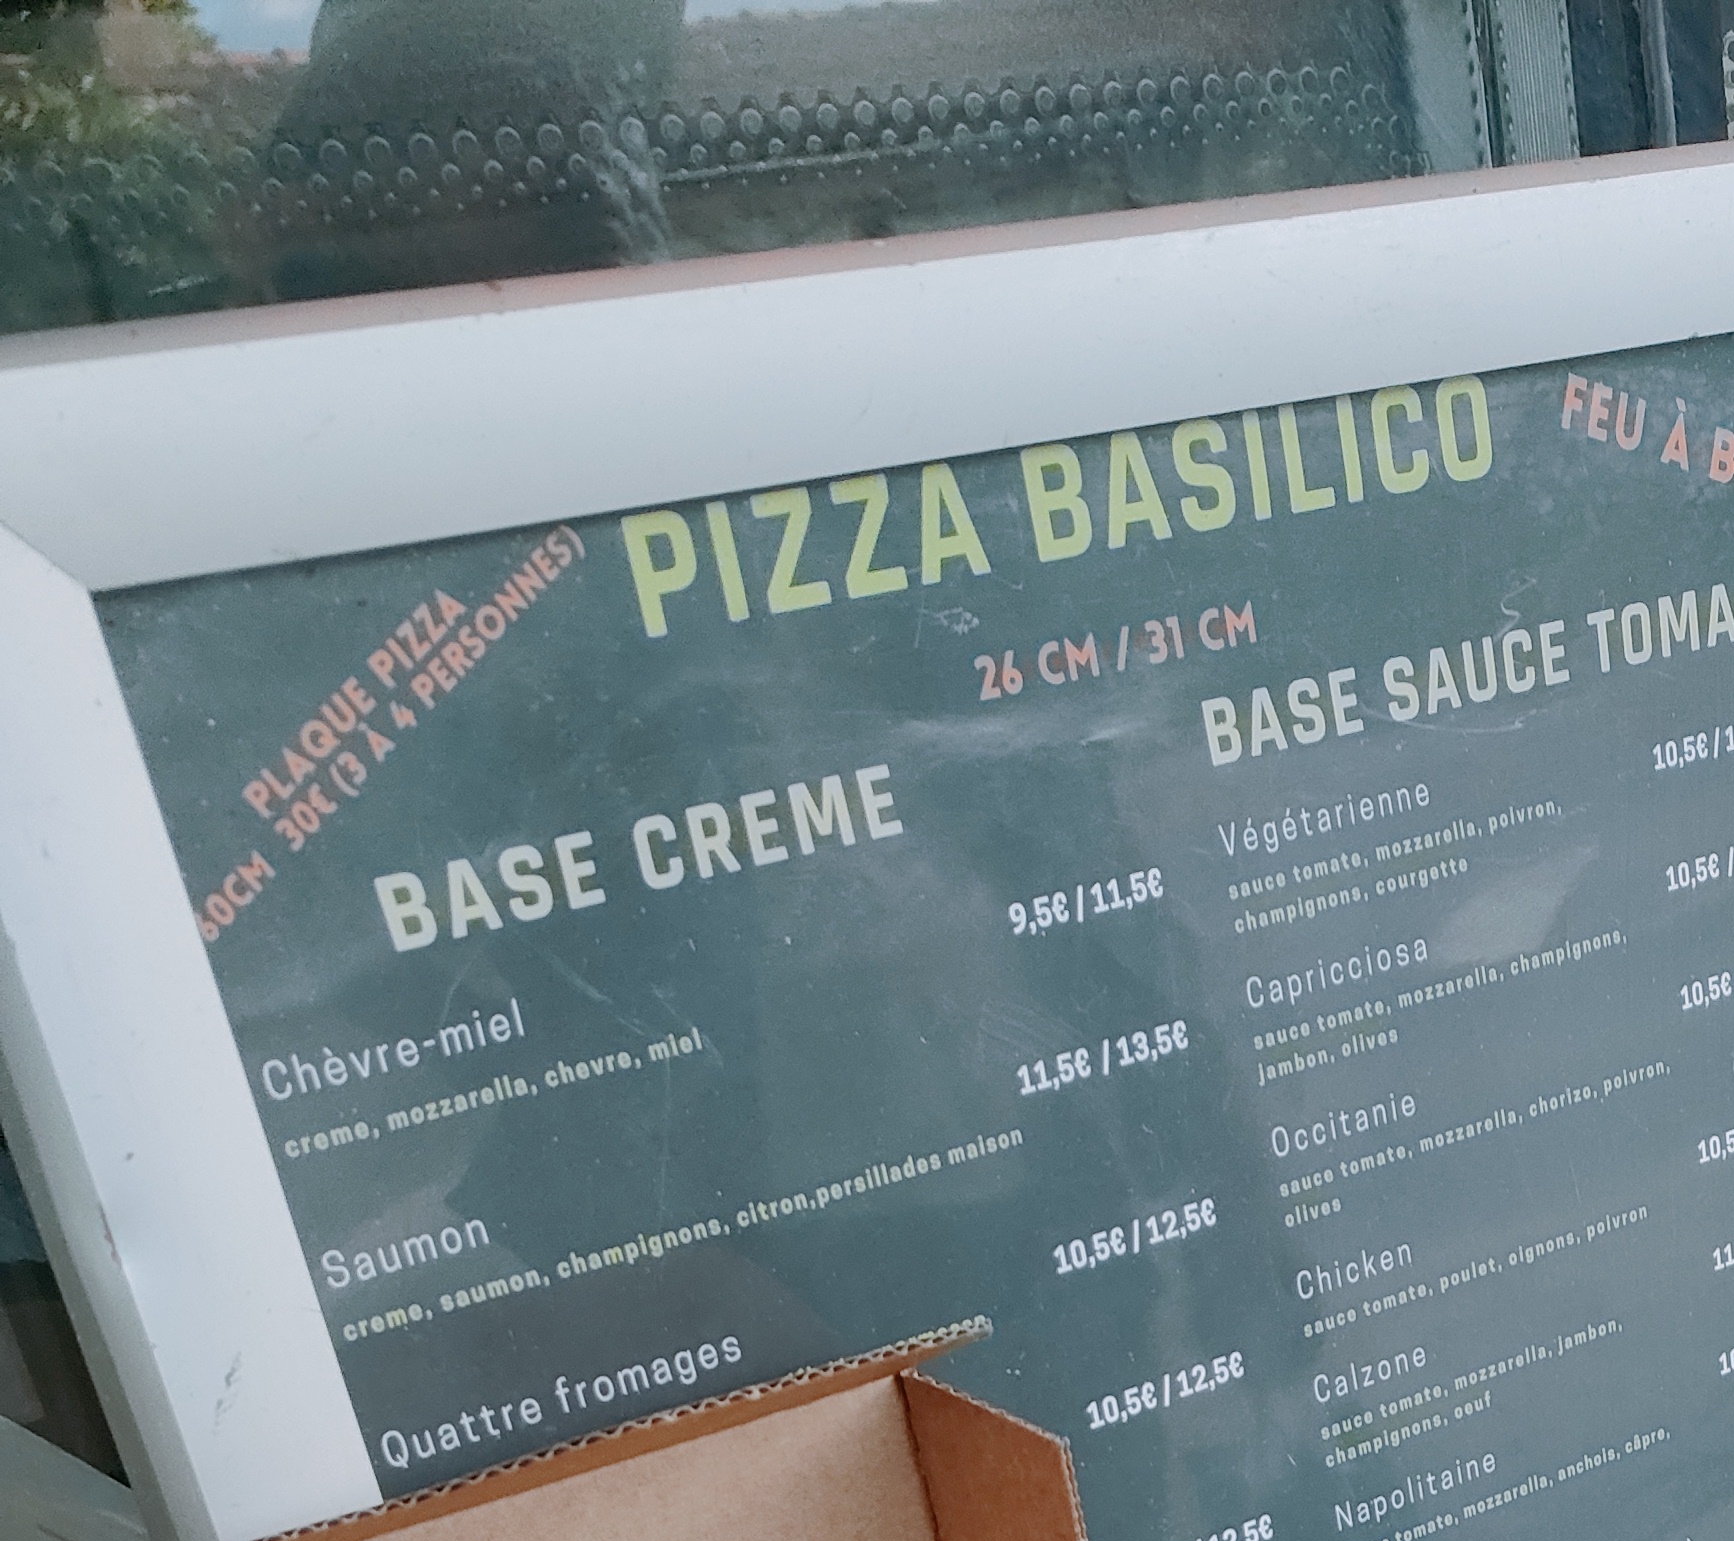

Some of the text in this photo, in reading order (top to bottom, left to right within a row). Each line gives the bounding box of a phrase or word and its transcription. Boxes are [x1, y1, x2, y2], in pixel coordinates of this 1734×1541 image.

[1561, 372, 1646, 451] FEU
[1661, 397, 1689, 471] À
[620, 374, 1494, 637] PIZZA BASILICO
[275, 782, 337, 852] 30€
[358, 721, 396, 762] À
[390, 702, 417, 729] 4
[410, 524, 586, 710] PERSONNES)
[973, 650, 1024, 701] 26
[1038, 633, 1100, 685] CM
[1144, 616, 1184, 664] 31
[1199, 600, 1257, 650] CM
[242, 589, 468, 818] PLAQUE PIZZA
[1201, 668, 1365, 766] BASE
[1383, 619, 1570, 721] SAUCE
[1653, 732, 1709, 770] 10,5€
[374, 763, 904, 951] BASE CREME
[1218, 782, 1430, 856] Végétarienne
[1228, 799, 1562, 901] sauce tomate, mozzarella, poivron,
[1235, 856, 1468, 934] champignons, courgette
[1666, 853, 1719, 892] 10,5€
[1008, 892, 1069, 935] 9,5€
[1246, 938, 1428, 1009] Capricciosa
[1254, 929, 1627, 1050] sauce tomate, mozzarella, champignons,
[1680, 971, 1732, 1011] 10,5€
[262, 997, 525, 1101] Chèvre-miel
[1017, 1047, 1091, 1095] 11,5€
[1257, 1029, 1398, 1087] jambon, olives
[284, 1026, 703, 1158] creme, mozzarella, chevre, miel
[1271, 1092, 1416, 1159] Occitanie
[1280, 1060, 1671, 1199] sauce tomate, mozzarella, chorizo, poivron,
[343, 1301, 433, 1341] creme,
[440, 1268, 550, 1312] saumon,
[557, 1216, 730, 1279] champignons,
[948, 1127, 1024, 1166] maison
[1053, 1227, 1127, 1275] 10,5€
[1285, 1197, 1342, 1229] olives
[320, 1218, 490, 1289] Saumon
[1297, 1242, 1413, 1300] Chicken
[1303, 1205, 1648, 1338] sauce tomate, poulet, oignons, poivron
[381, 1335, 743, 1468] Quattre fromages
[1085, 1381, 1157, 1430] 10,5€
[1313, 1346, 1427, 1404] Calzone
[1320, 1318, 1623, 1441] sauce tomate, mozzarella, jambon,
[1325, 1390, 1494, 1468] champignons, oeuf
[1334, 1452, 1497, 1532] Napolitaine
[1463, 1474, 1554, 1519] mozzarella,
[1558, 1449, 1621, 1481] anchois,
